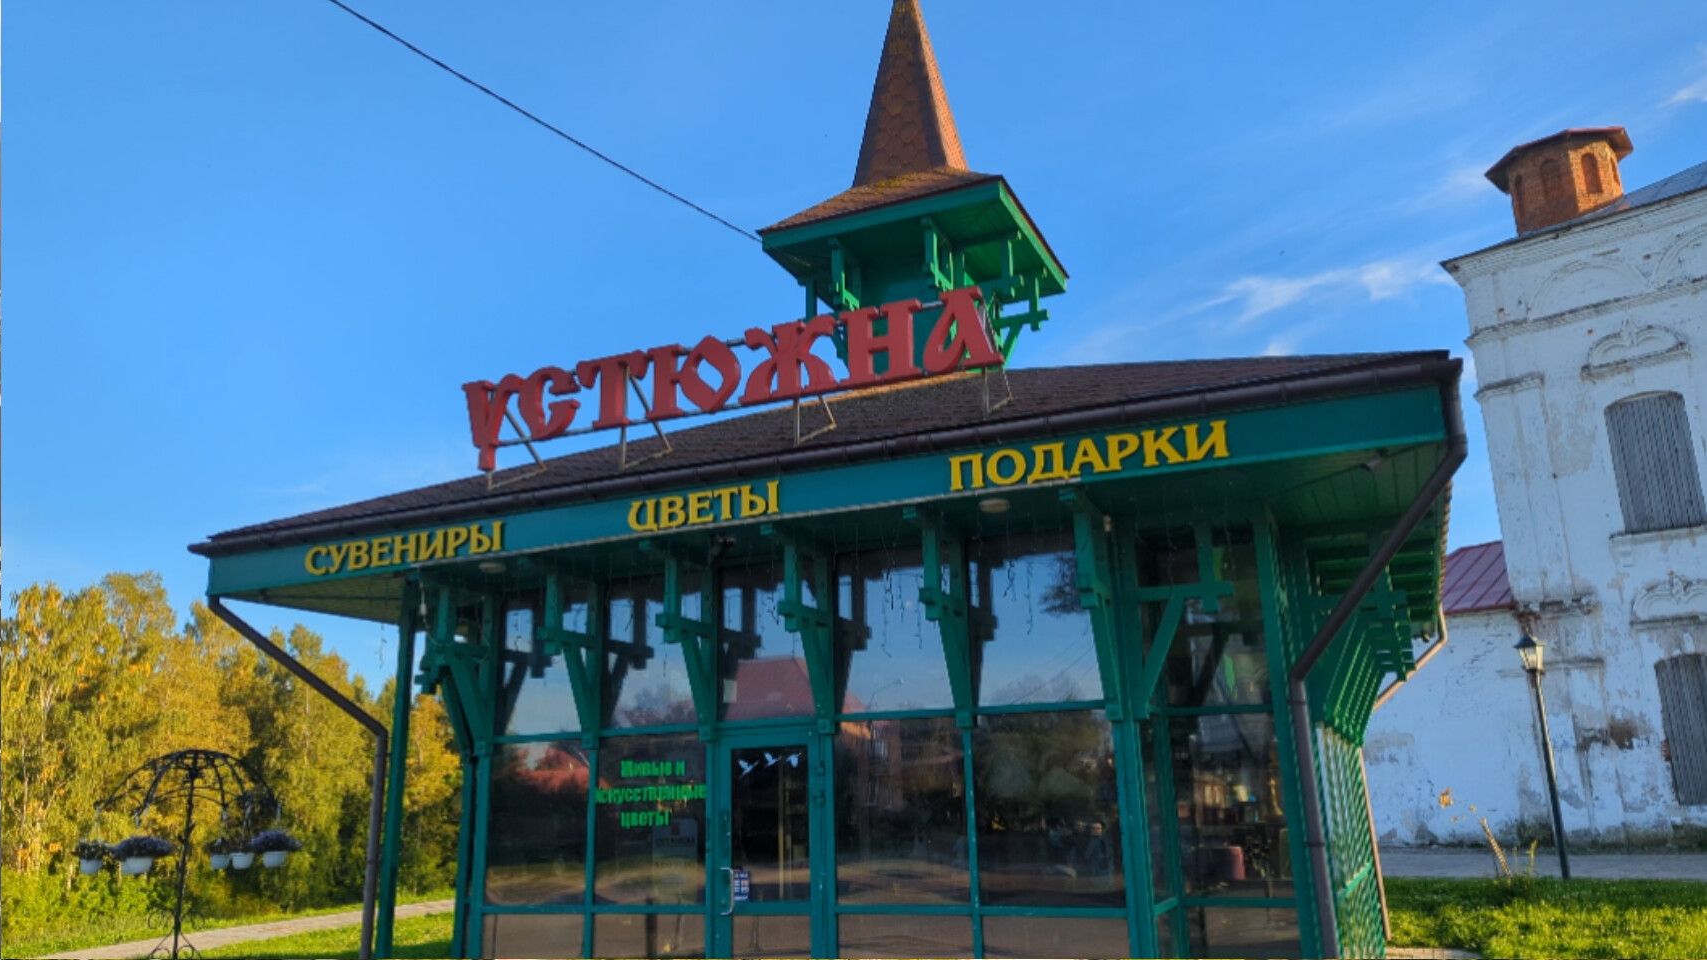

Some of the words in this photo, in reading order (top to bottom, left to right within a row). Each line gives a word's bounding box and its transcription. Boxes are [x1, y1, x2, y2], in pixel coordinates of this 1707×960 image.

[462, 286, 1004, 470] УСТЮЖНА
[304, 521, 503, 575] СУВЕНИРЫ
[627, 481, 780, 533] ЦВЕТЫ
[948, 419, 1230, 486] ПОДАРКИ
[621, 760, 672, 777] Живые
